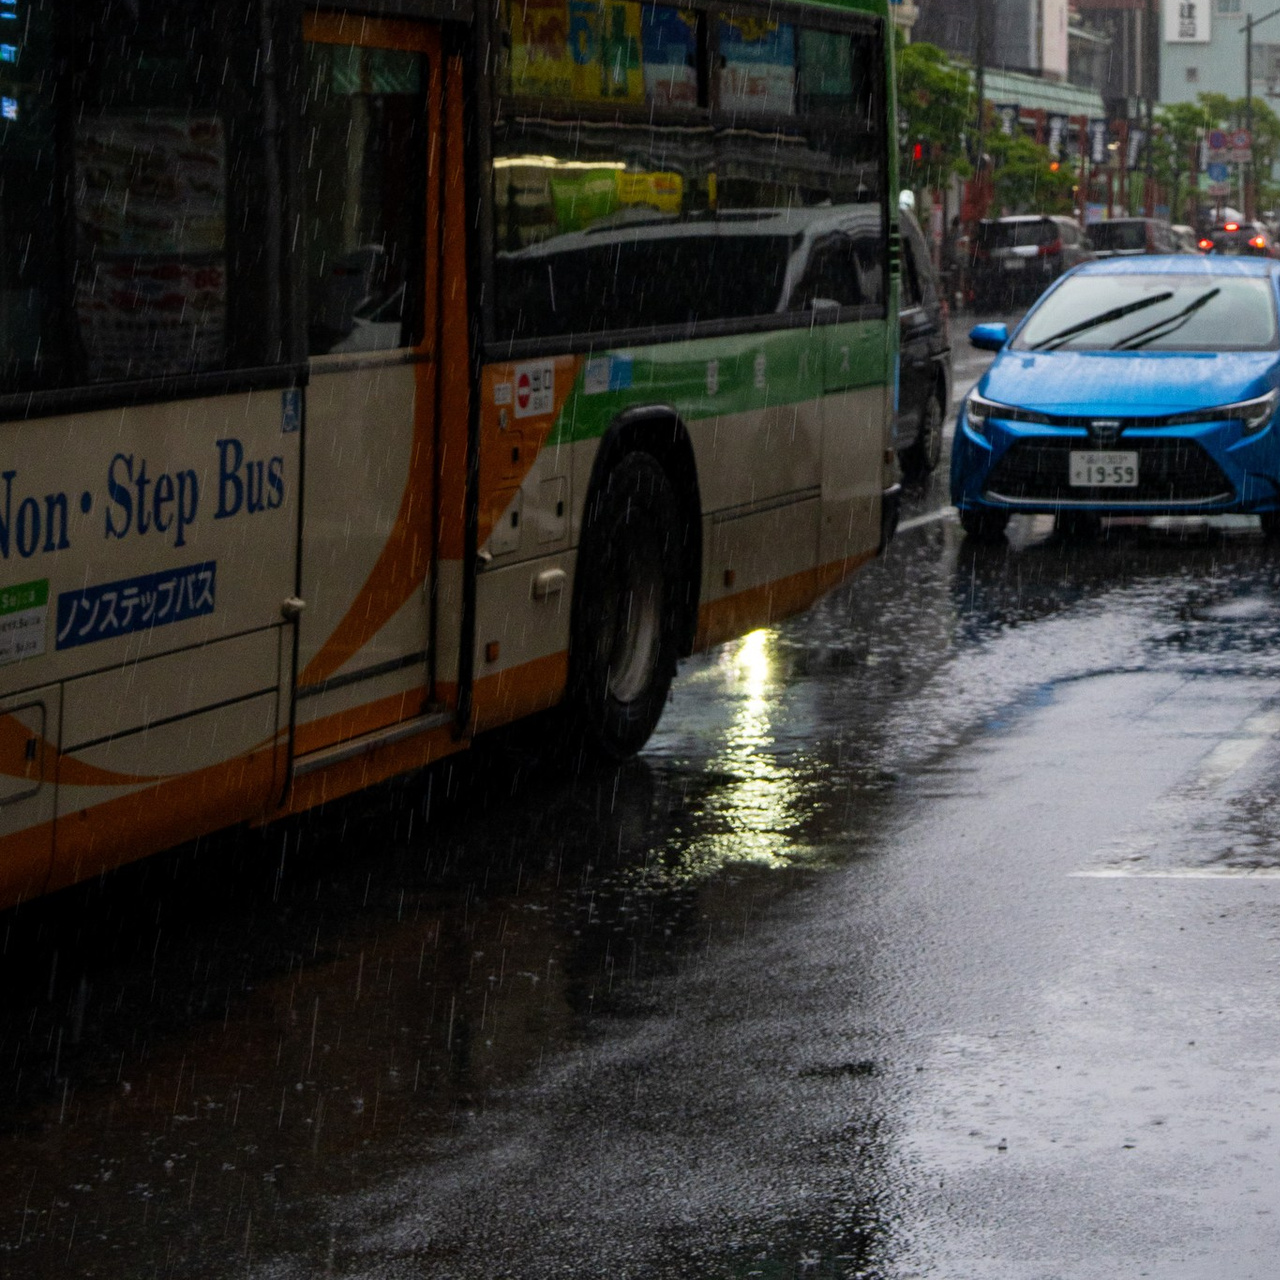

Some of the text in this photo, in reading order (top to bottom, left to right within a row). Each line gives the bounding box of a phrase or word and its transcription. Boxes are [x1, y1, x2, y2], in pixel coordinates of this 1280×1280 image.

[105, 453, 199, 548] Step
[214, 438, 285, 519] Bus
[58, 570, 214, 642] ノンステップバス
